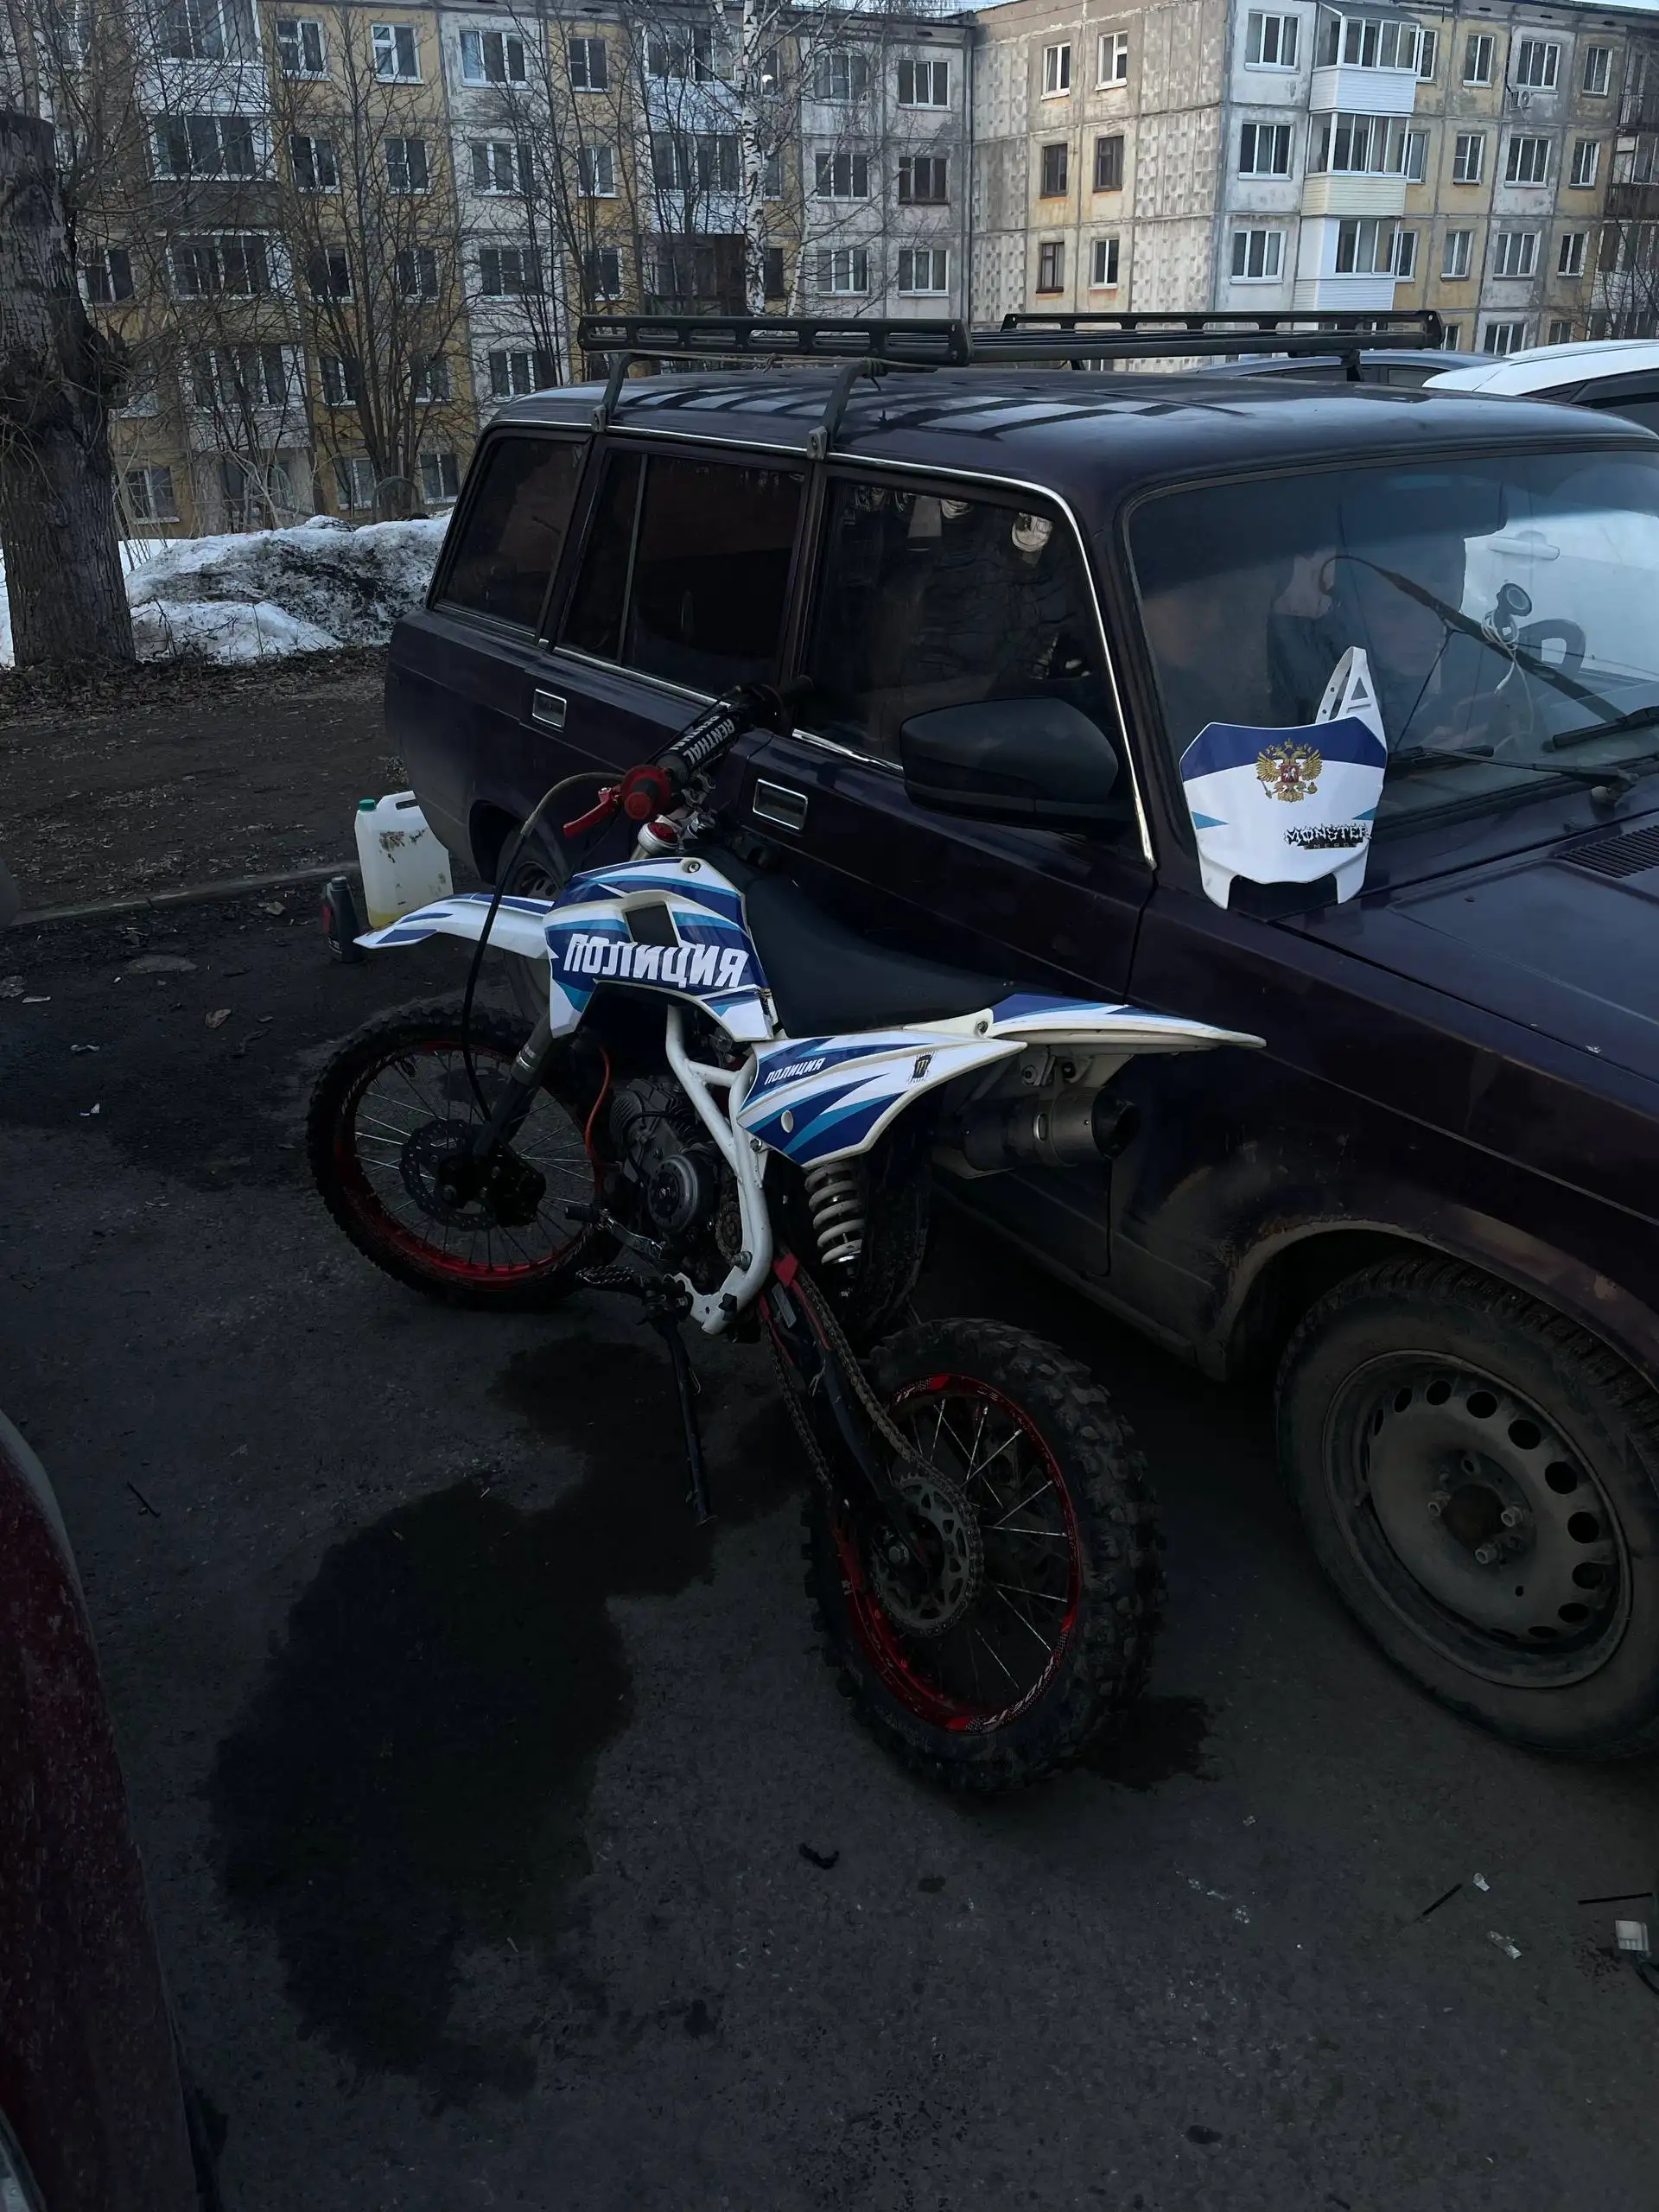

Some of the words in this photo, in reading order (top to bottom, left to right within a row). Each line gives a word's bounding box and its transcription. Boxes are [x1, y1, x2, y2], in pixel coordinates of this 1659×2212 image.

[683, 718, 736, 766] RENTHAL
[1283, 823, 1371, 845] MONSTER
[563, 933, 749, 988] ПОЛИЦИЯ
[765, 1057, 826, 1086] ПОЛИЦИЯ
